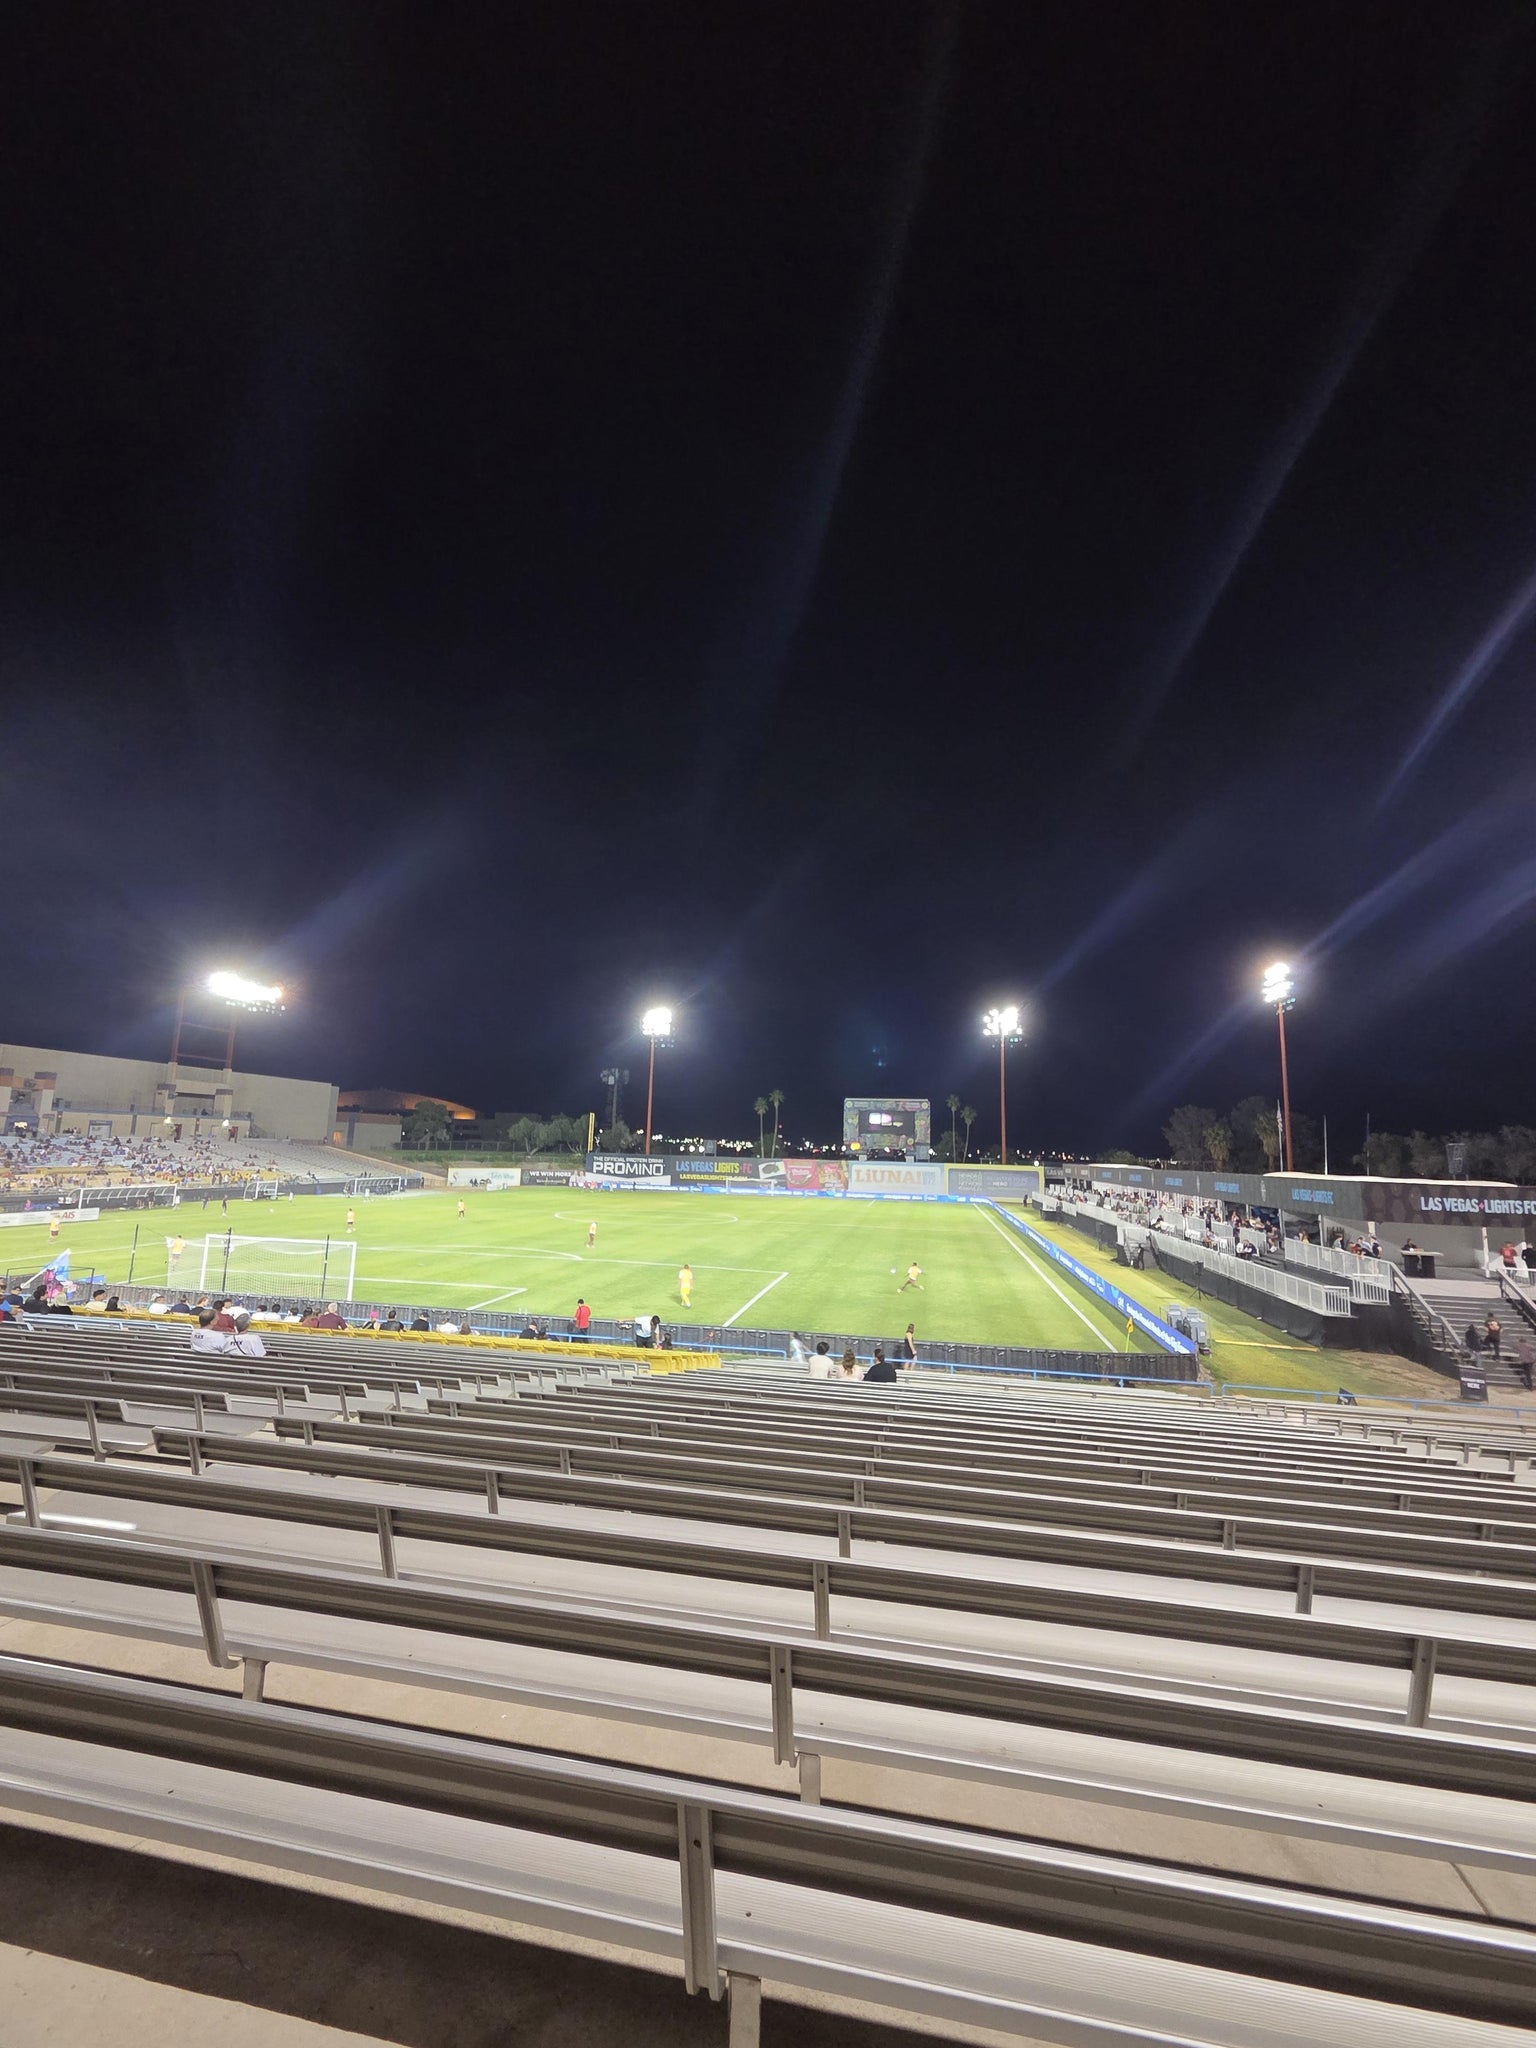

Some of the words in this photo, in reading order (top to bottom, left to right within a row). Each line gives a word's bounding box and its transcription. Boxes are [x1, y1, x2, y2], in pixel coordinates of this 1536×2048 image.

[593, 1161, 664, 1176] PROMINO
[675, 1160, 689, 1172] LAS
[690, 1161, 714, 1173] VEGAS
[714, 1162, 739, 1174] LIGHTS
[742, 1163, 753, 1174] FC
[1420, 1196, 1442, 1211] LAS
[1443, 1197, 1479, 1213] VEGAS
[1484, 1199, 1524, 1214] LIGHTS
[1523, 1200, 1536, 1215] FC
